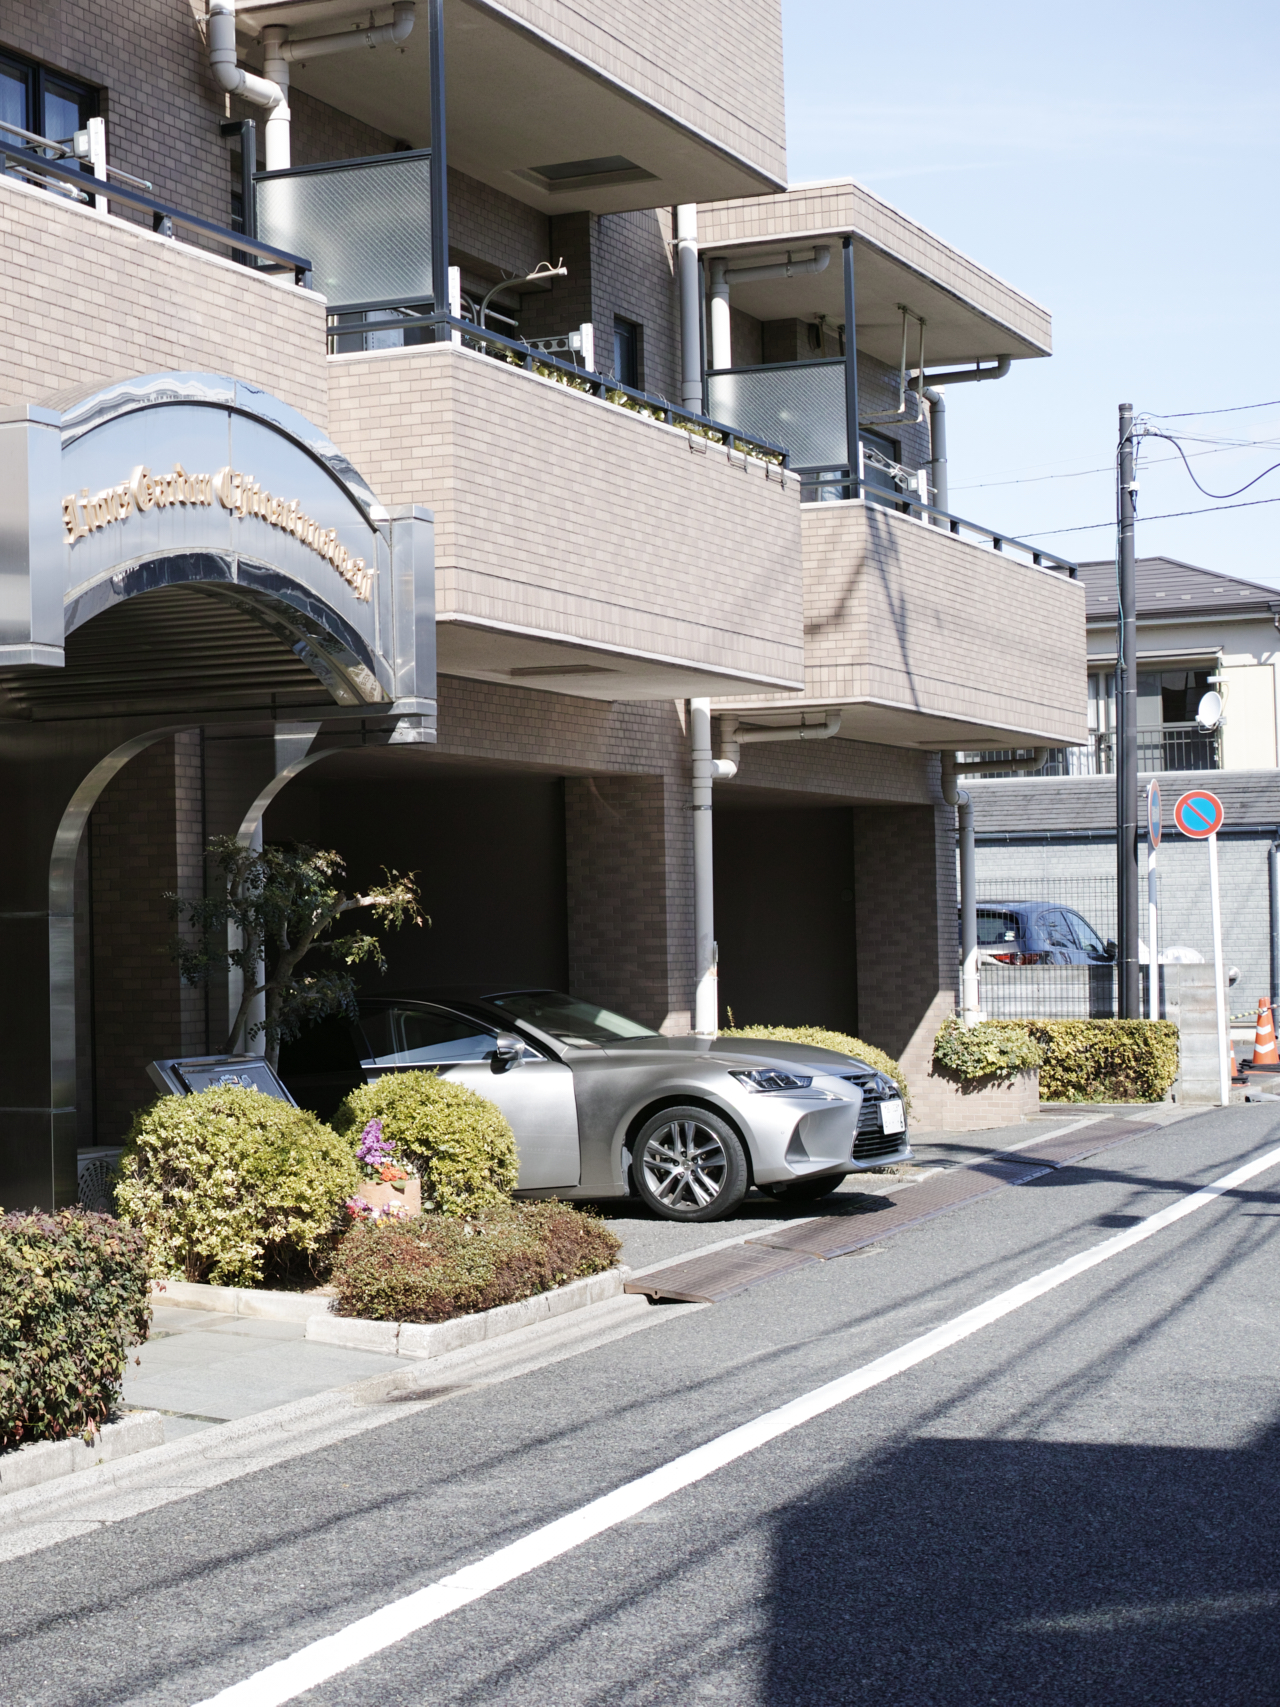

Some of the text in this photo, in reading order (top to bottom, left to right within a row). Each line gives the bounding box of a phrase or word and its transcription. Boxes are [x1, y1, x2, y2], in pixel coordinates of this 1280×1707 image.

[61, 463, 375, 603] Lions Garden Chitosefunabashi
